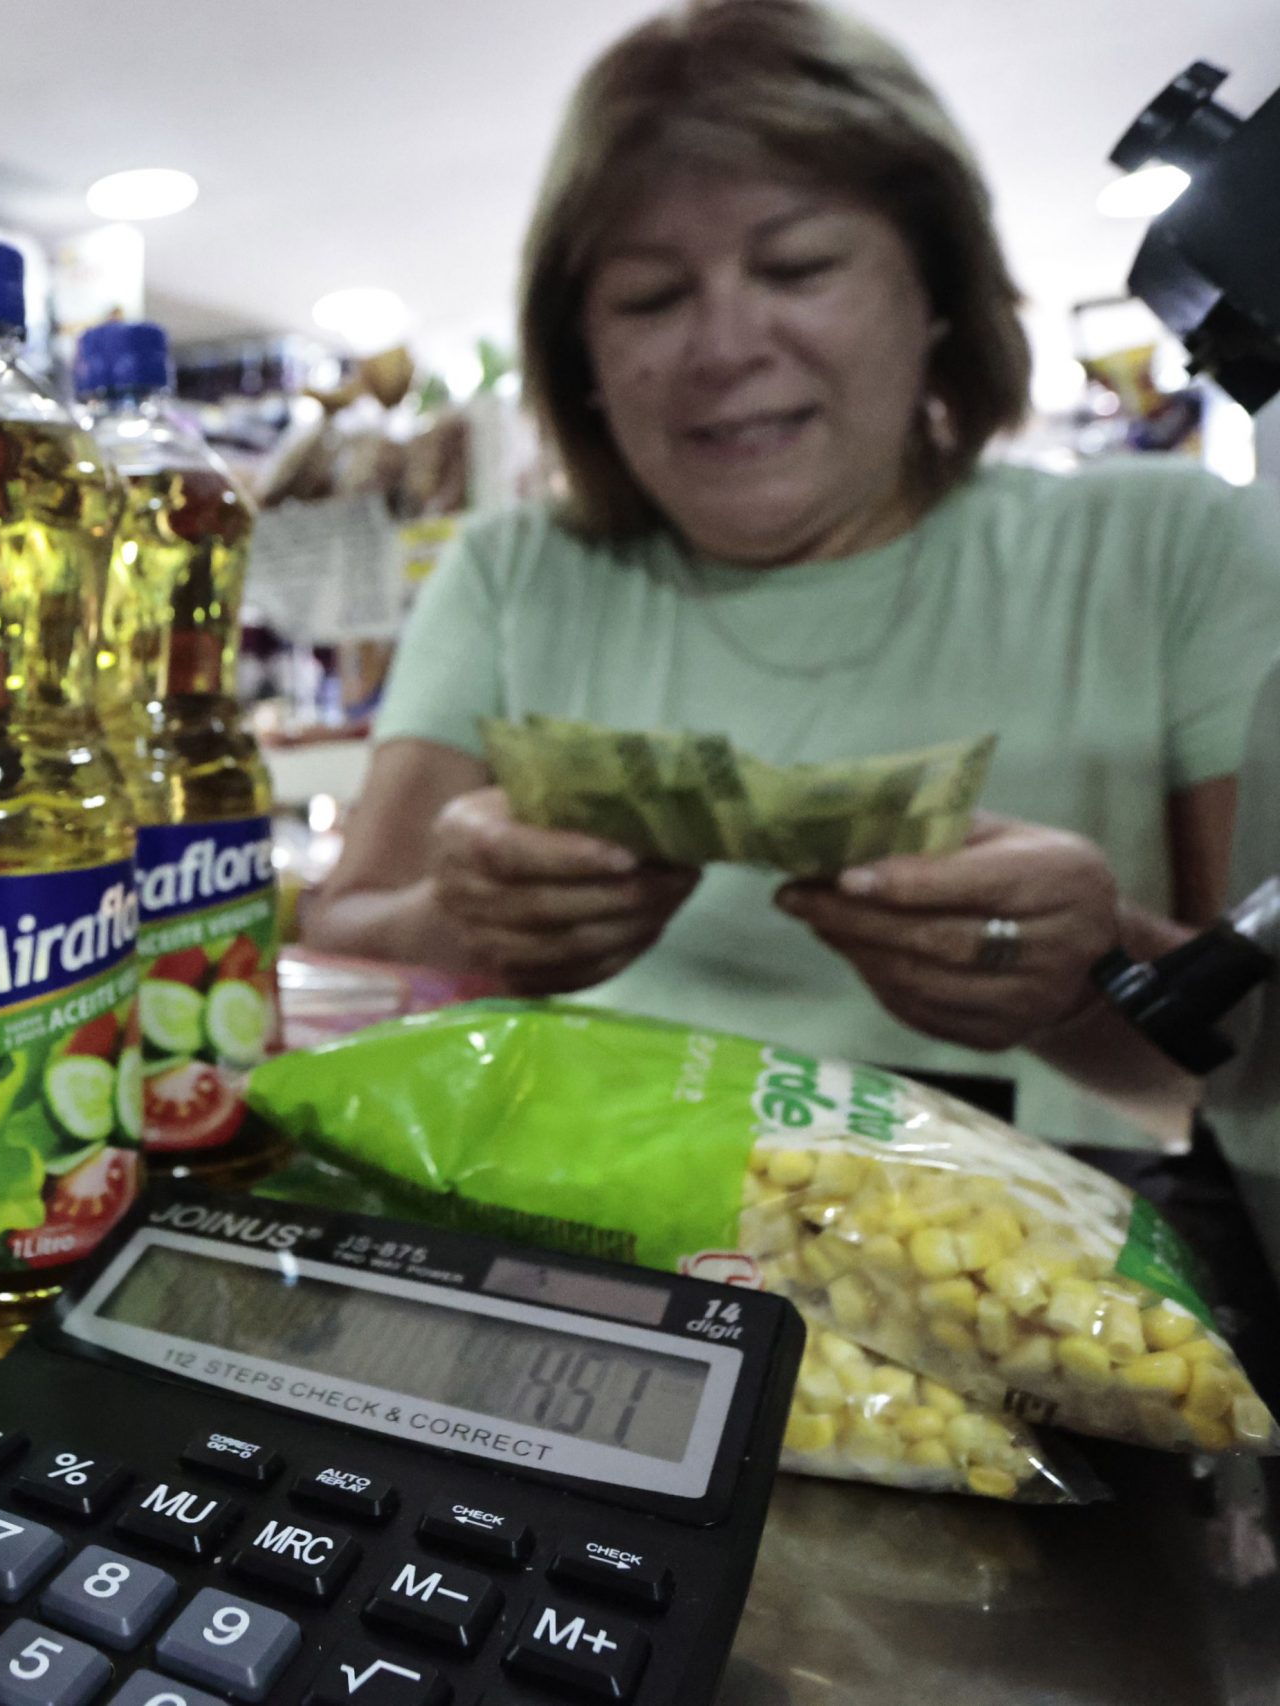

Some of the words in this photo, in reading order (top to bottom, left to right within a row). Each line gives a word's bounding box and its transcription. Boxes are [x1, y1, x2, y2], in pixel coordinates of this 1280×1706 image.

[704, 1299, 742, 1323] 14
[685, 1319, 743, 1340] digit
[163, 1349, 196, 1369] 112
[204, 1359, 285, 1392] STEPS
[288, 1382, 381, 1418] CHECK
[384, 1406, 402, 1424] &
[409, 1412, 553, 1462] CORRECT
[47, 1452, 96, 1486] %
[315, 1474, 367, 1493] REPLAY
[319, 1468, 371, 1486] AUTO
[139, 1482, 218, 1525] MU
[451, 1504, 505, 1527] CHECK
[252, 1520, 334, 1566] MRC
[585, 1542, 643, 1567] CHECK
[82, 1562, 131, 1598] 8
[202, 1606, 251, 1646] 9
[532, 1607, 618, 1654] M+
[8, 1636, 65, 1681] 5
